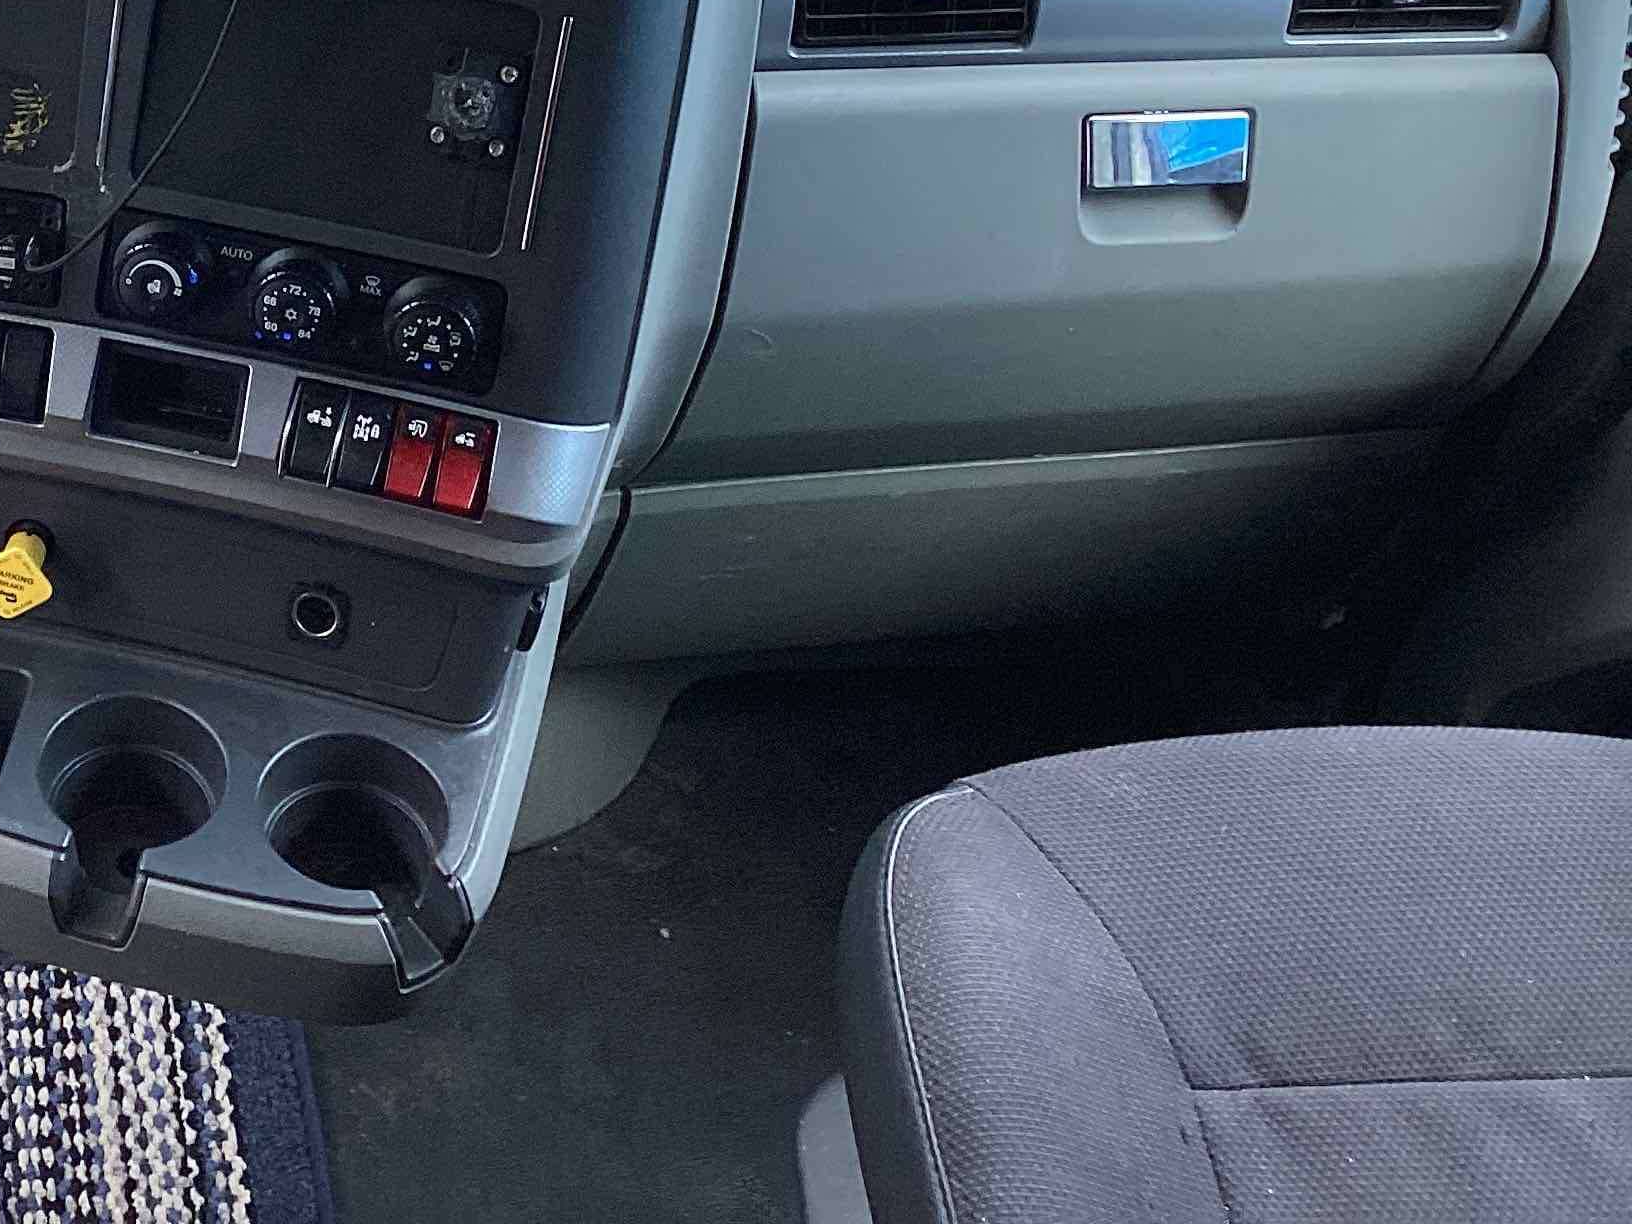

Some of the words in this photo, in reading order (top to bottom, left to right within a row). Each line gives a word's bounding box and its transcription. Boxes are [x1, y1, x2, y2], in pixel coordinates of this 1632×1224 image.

[220, 245, 254, 262] AUTO
[288, 284, 302, 296] 72
[360, 284, 382, 297] MAX
[264, 321, 278, 332] 60
[297, 329, 312, 340] 84
